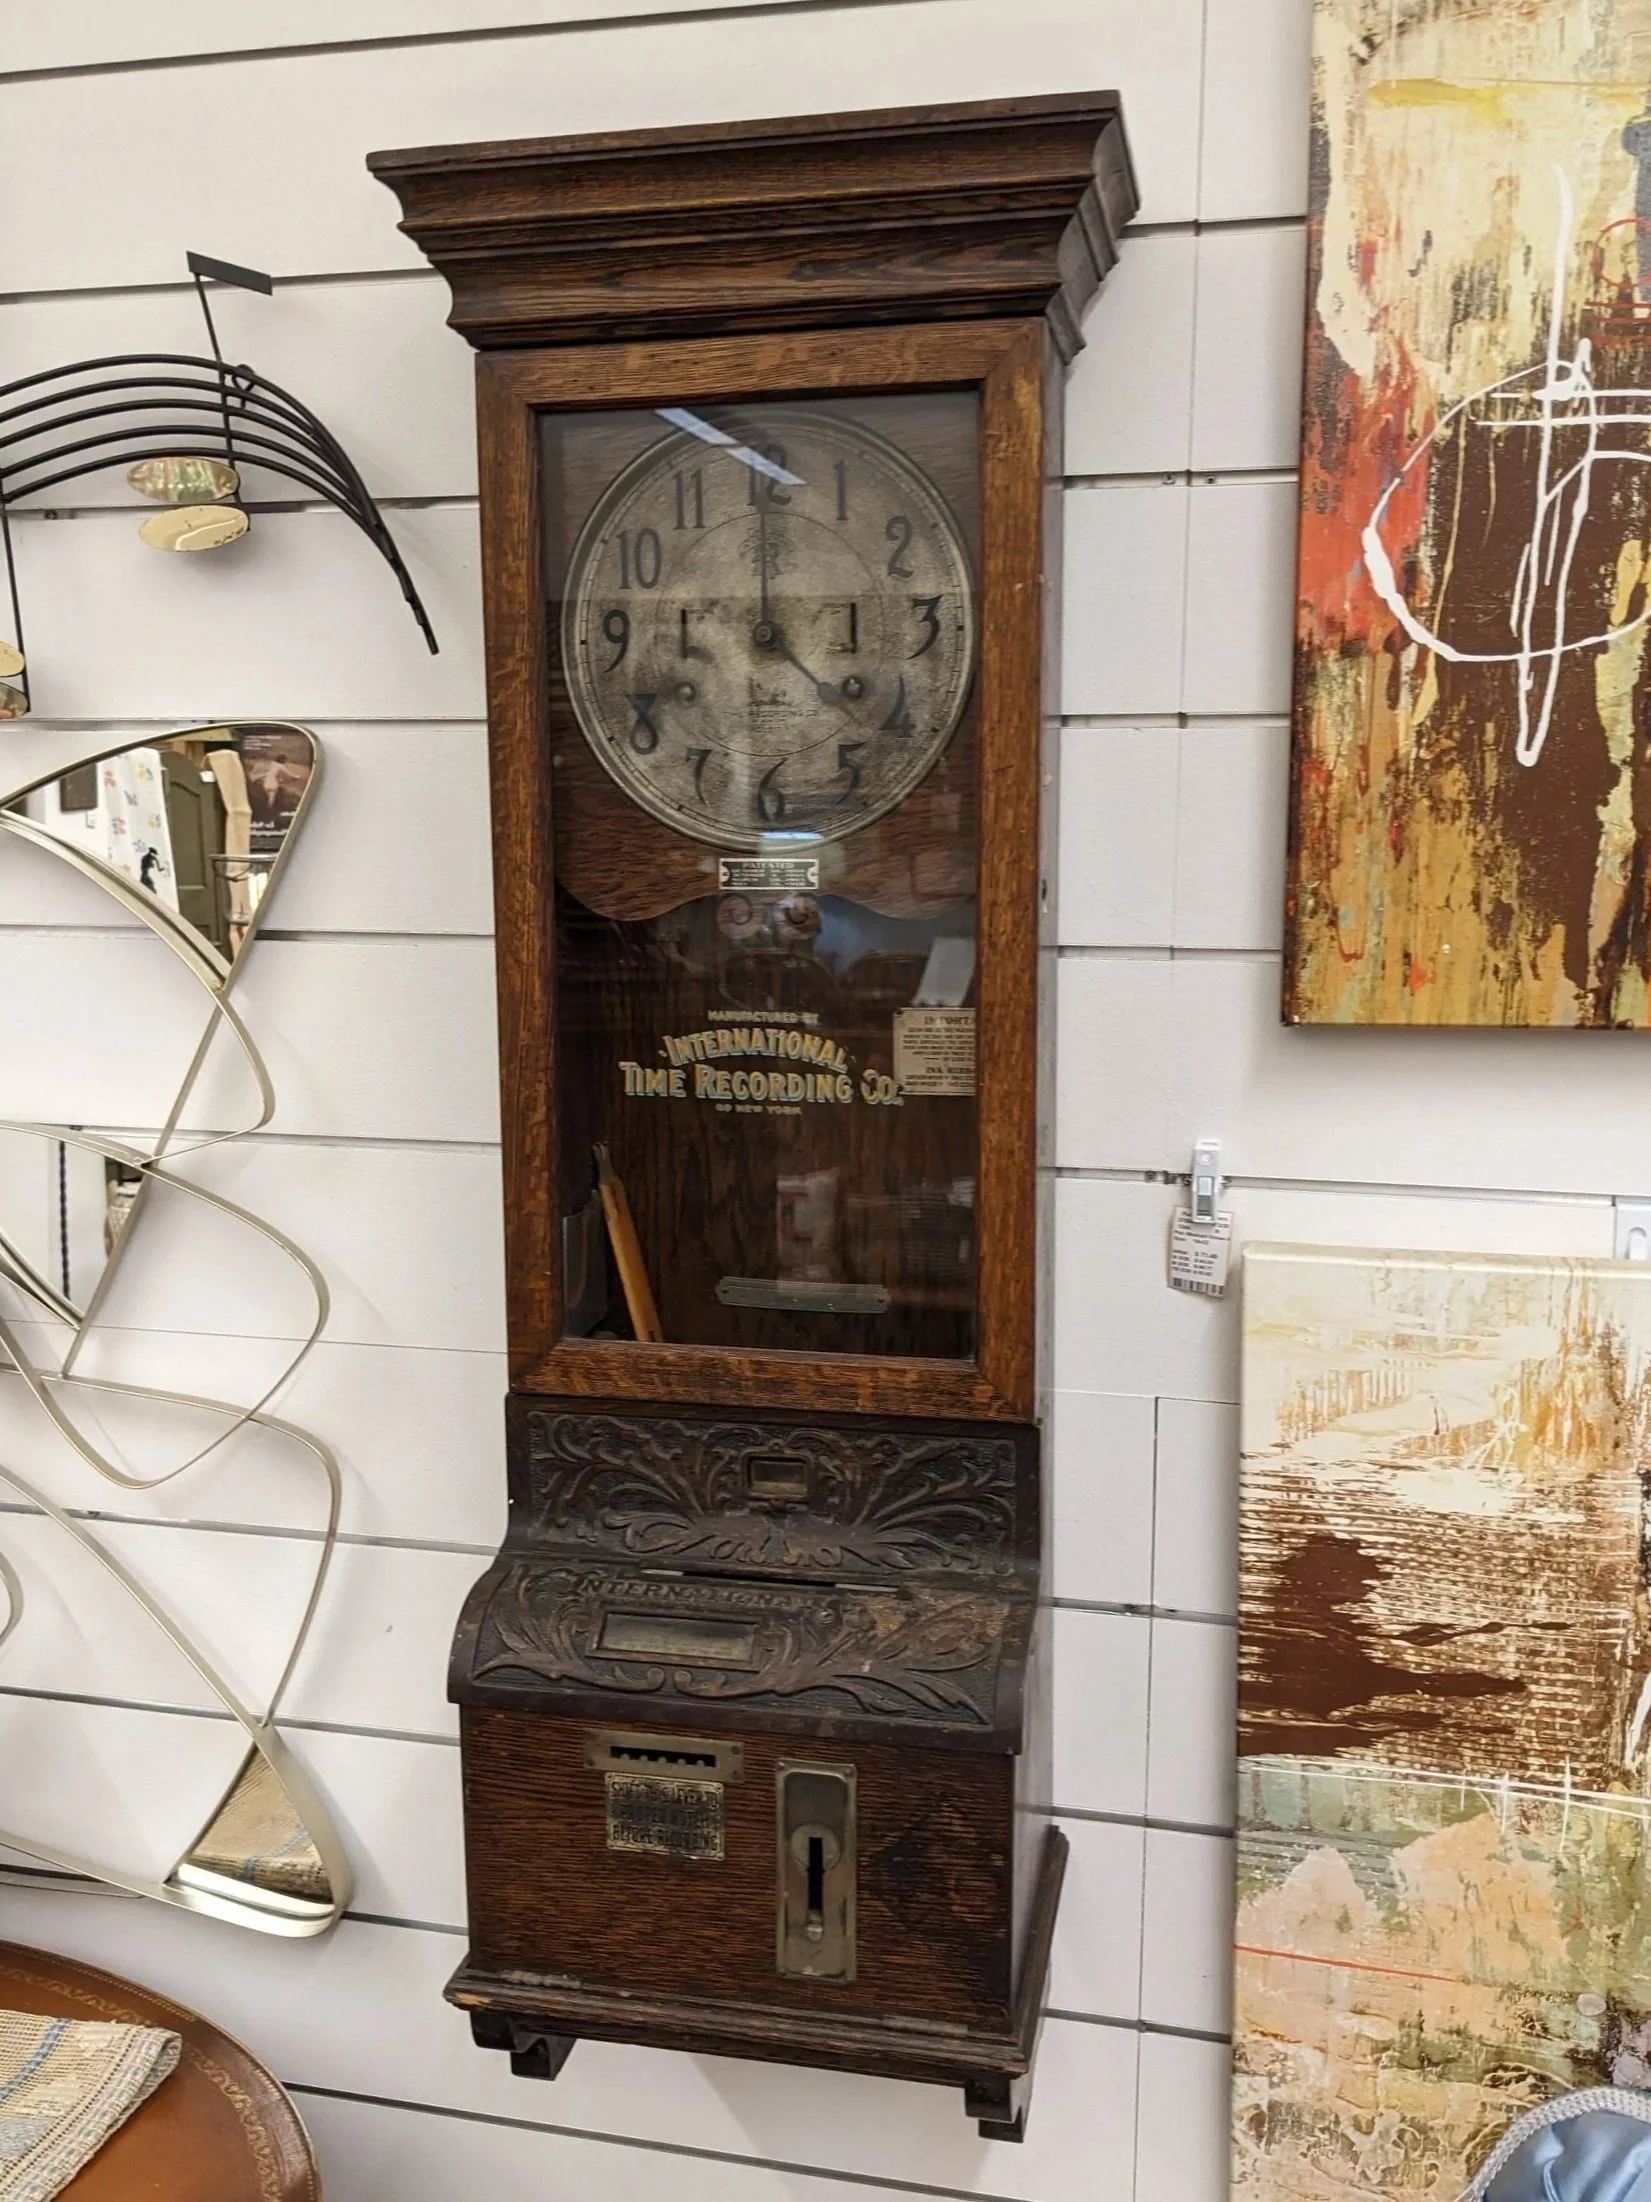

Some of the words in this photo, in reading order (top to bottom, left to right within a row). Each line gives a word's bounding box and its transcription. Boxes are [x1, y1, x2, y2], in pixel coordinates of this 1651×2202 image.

[672, 469, 706, 530] 11
[748, 444, 792, 507] 12
[833, 460, 849, 521] 1
[616, 528, 662, 589] 10
[885, 516, 914, 580] 2
[602, 609, 630, 673] 9
[907, 595, 943, 659] 3
[626, 693, 659, 755] 8
[879, 676, 915, 738] 4
[685, 747, 713, 806] 7
[757, 757, 788, 822] 6
[836, 741, 866, 804] 5
[662, 1028, 849, 1074] INTERNATIONAL
[618, 1061, 687, 1098] TIME
[694, 1063, 853, 1104] RECORDING
